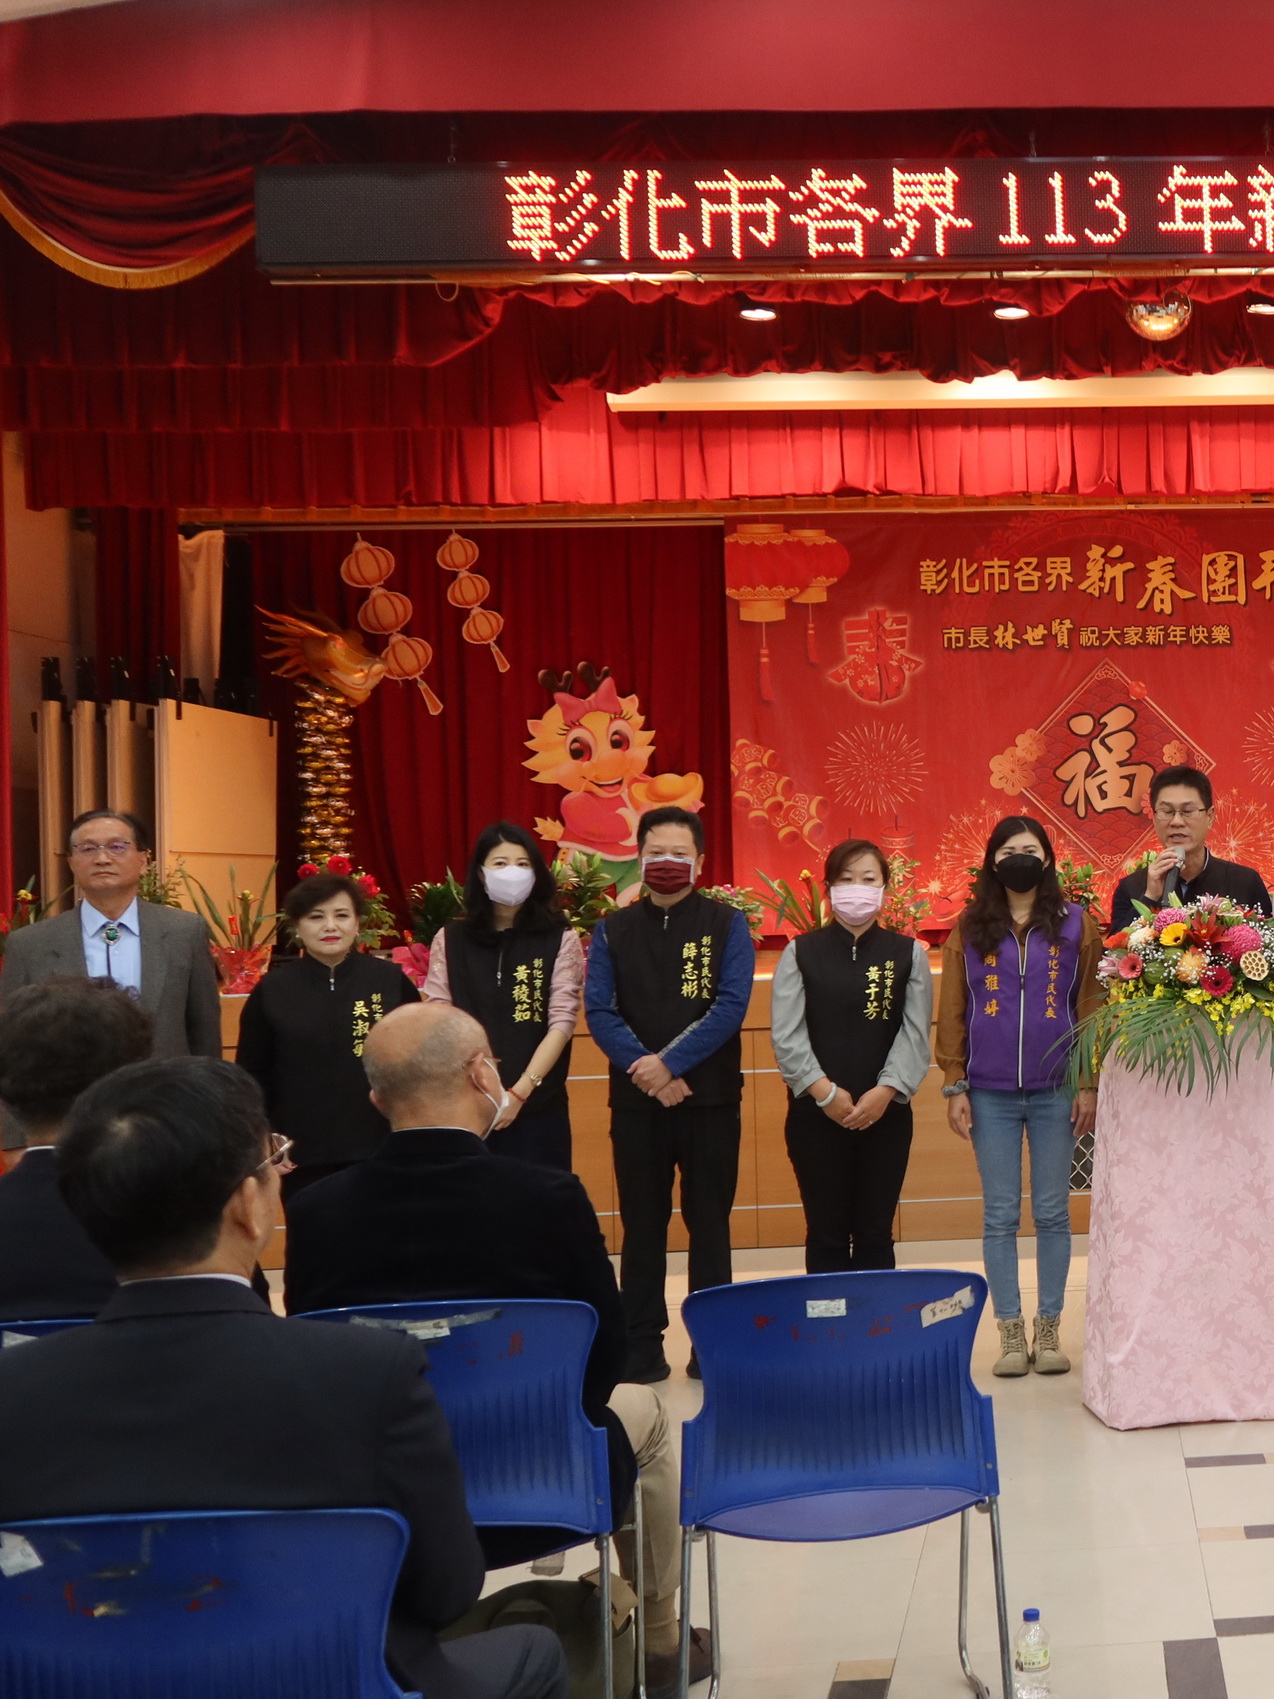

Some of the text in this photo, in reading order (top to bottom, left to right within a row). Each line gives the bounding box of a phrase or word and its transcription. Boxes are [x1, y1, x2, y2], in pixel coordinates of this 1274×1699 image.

[503, 166, 973, 262] 彰化市各界
[1000, 169, 1127, 246] 113
[1053, 703, 1157, 820] 福
[512, 964, 532, 1023] 黃稜茹
[532, 957, 544, 1023] 彰化市民代表
[680, 941, 699, 1000] 薛志彬
[701, 934, 712, 1000] 彰化市民代表
[863, 965, 882, 1021] 黃于芳
[882, 960, 895, 1021] 彰化市民代表
[1044, 945, 1059, 1019] 彰化市民代表
